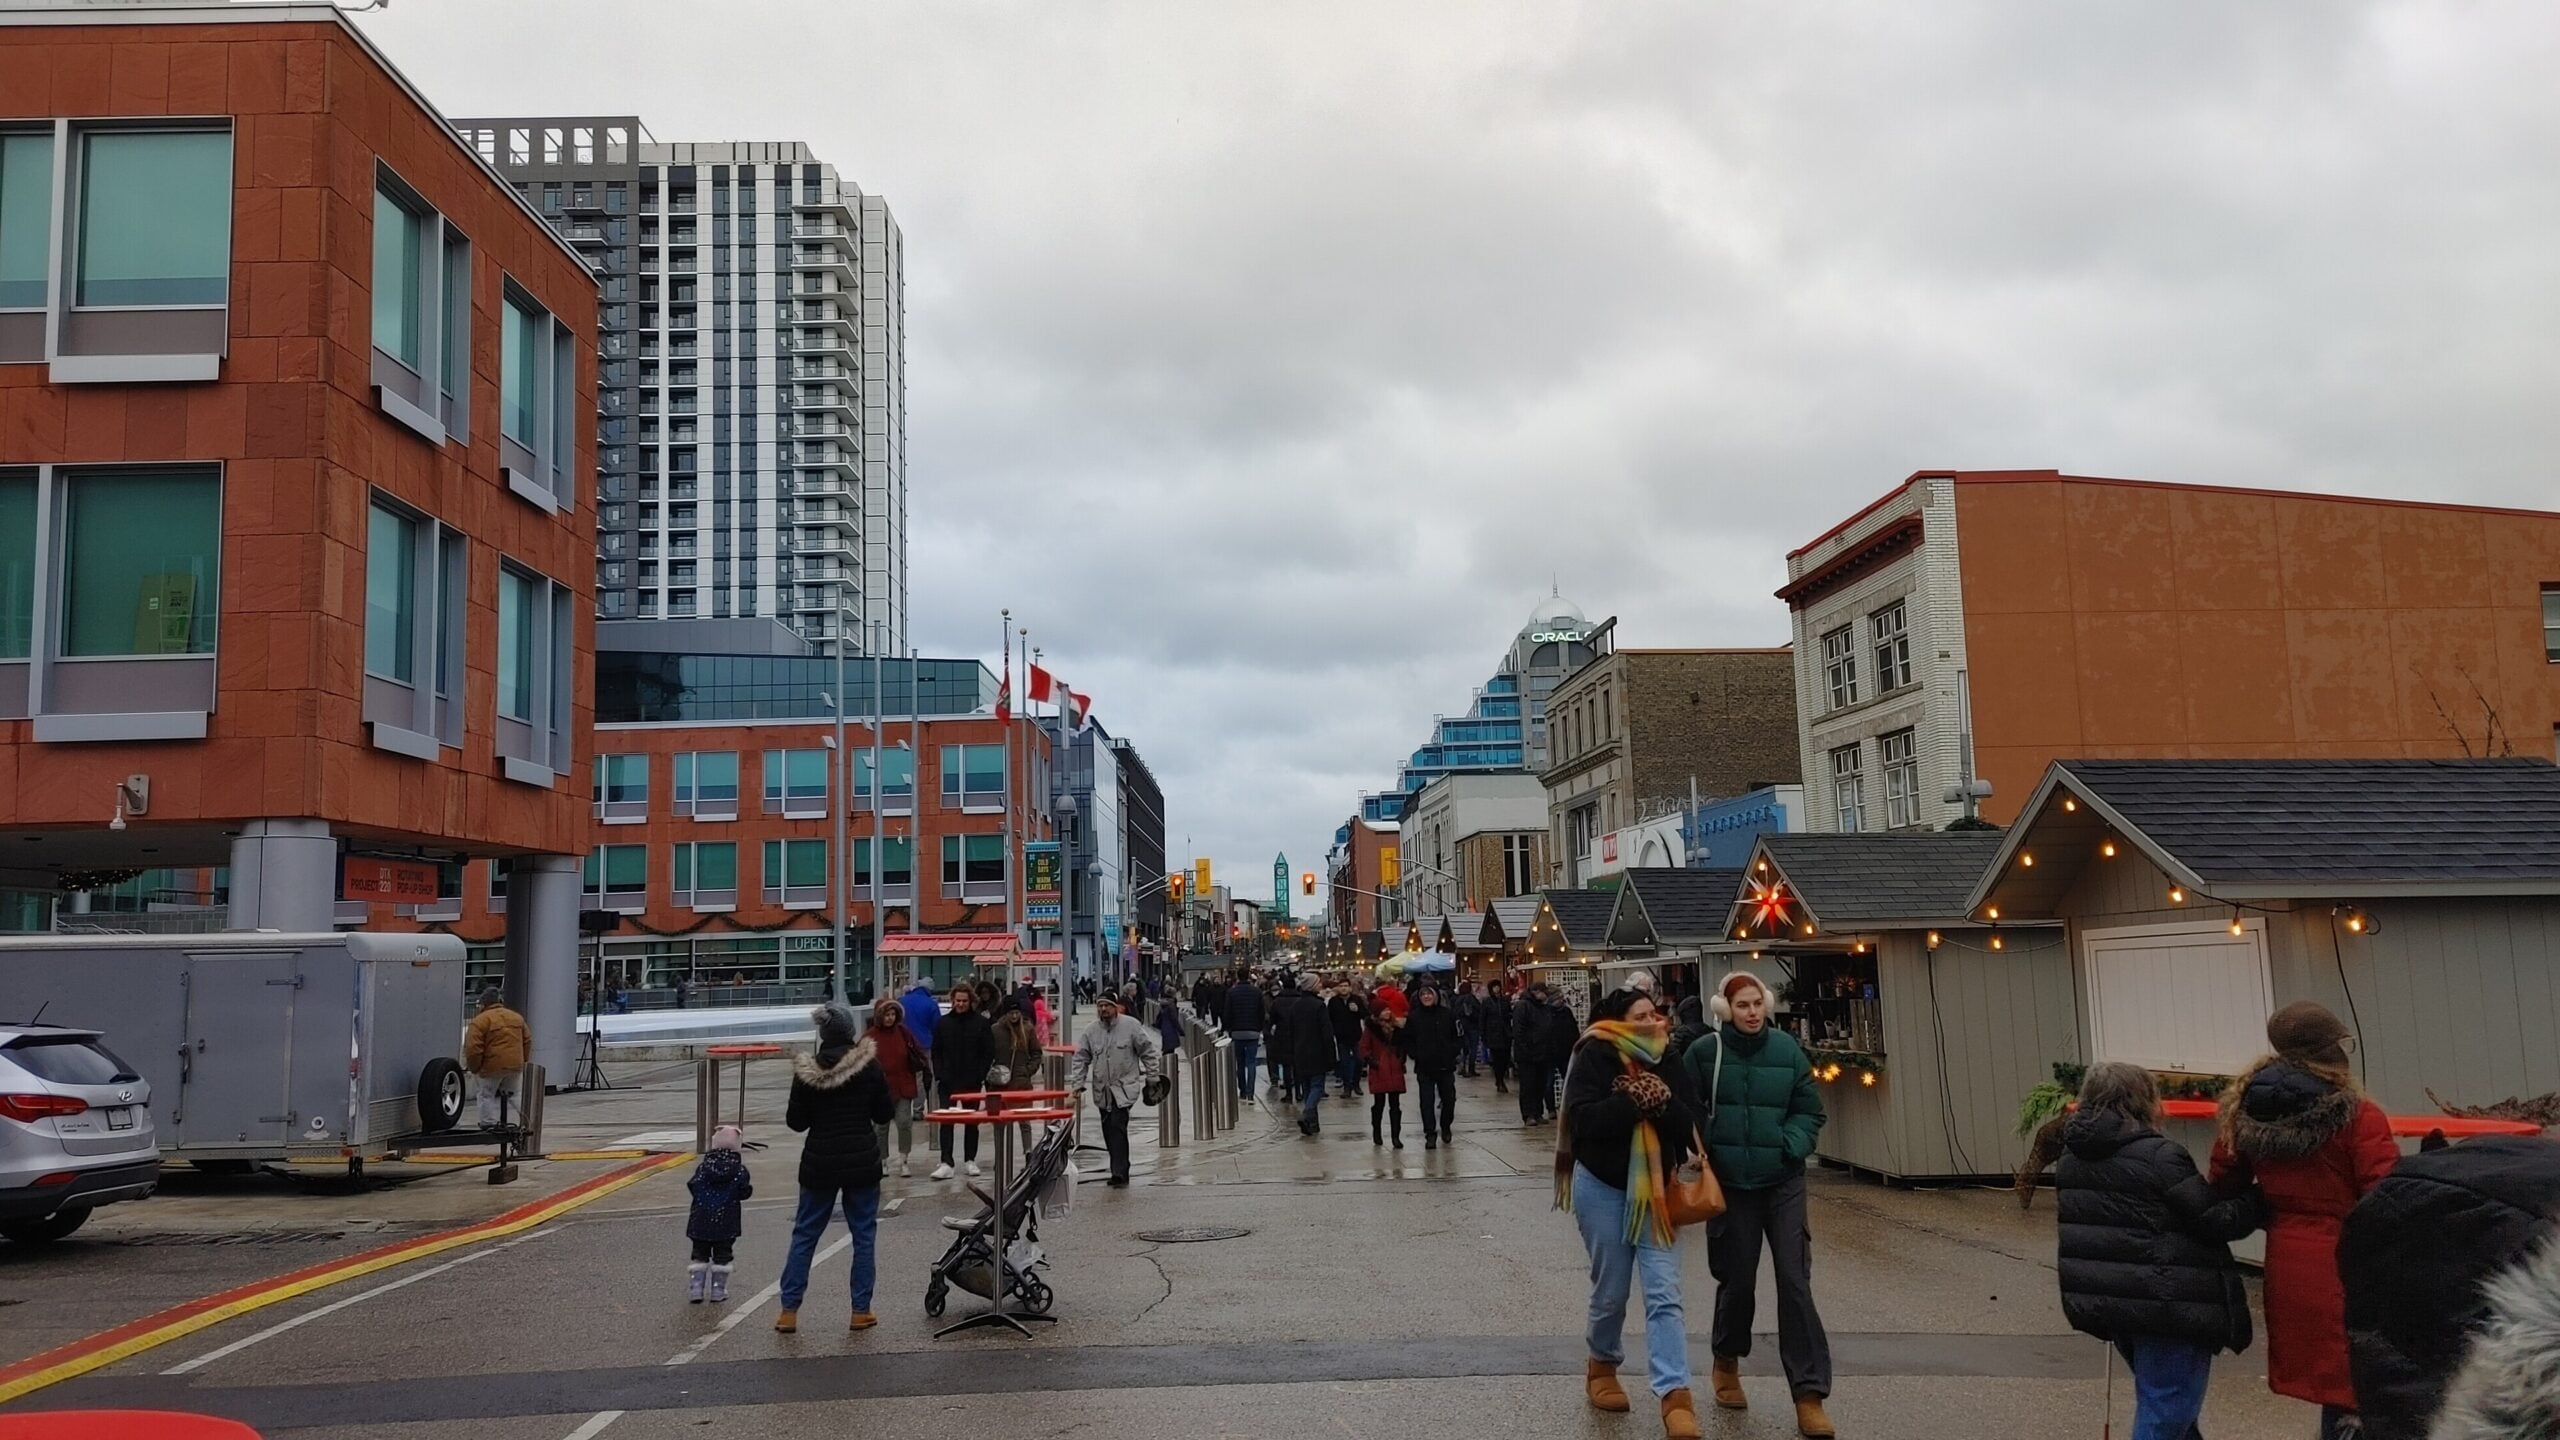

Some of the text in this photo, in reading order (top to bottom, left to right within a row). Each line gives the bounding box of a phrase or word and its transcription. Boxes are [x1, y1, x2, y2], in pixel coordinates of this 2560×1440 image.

[379, 867, 392, 880] DTK
[351, 878, 380, 892] PROJECT
[795, 937, 828, 950] OPEN
